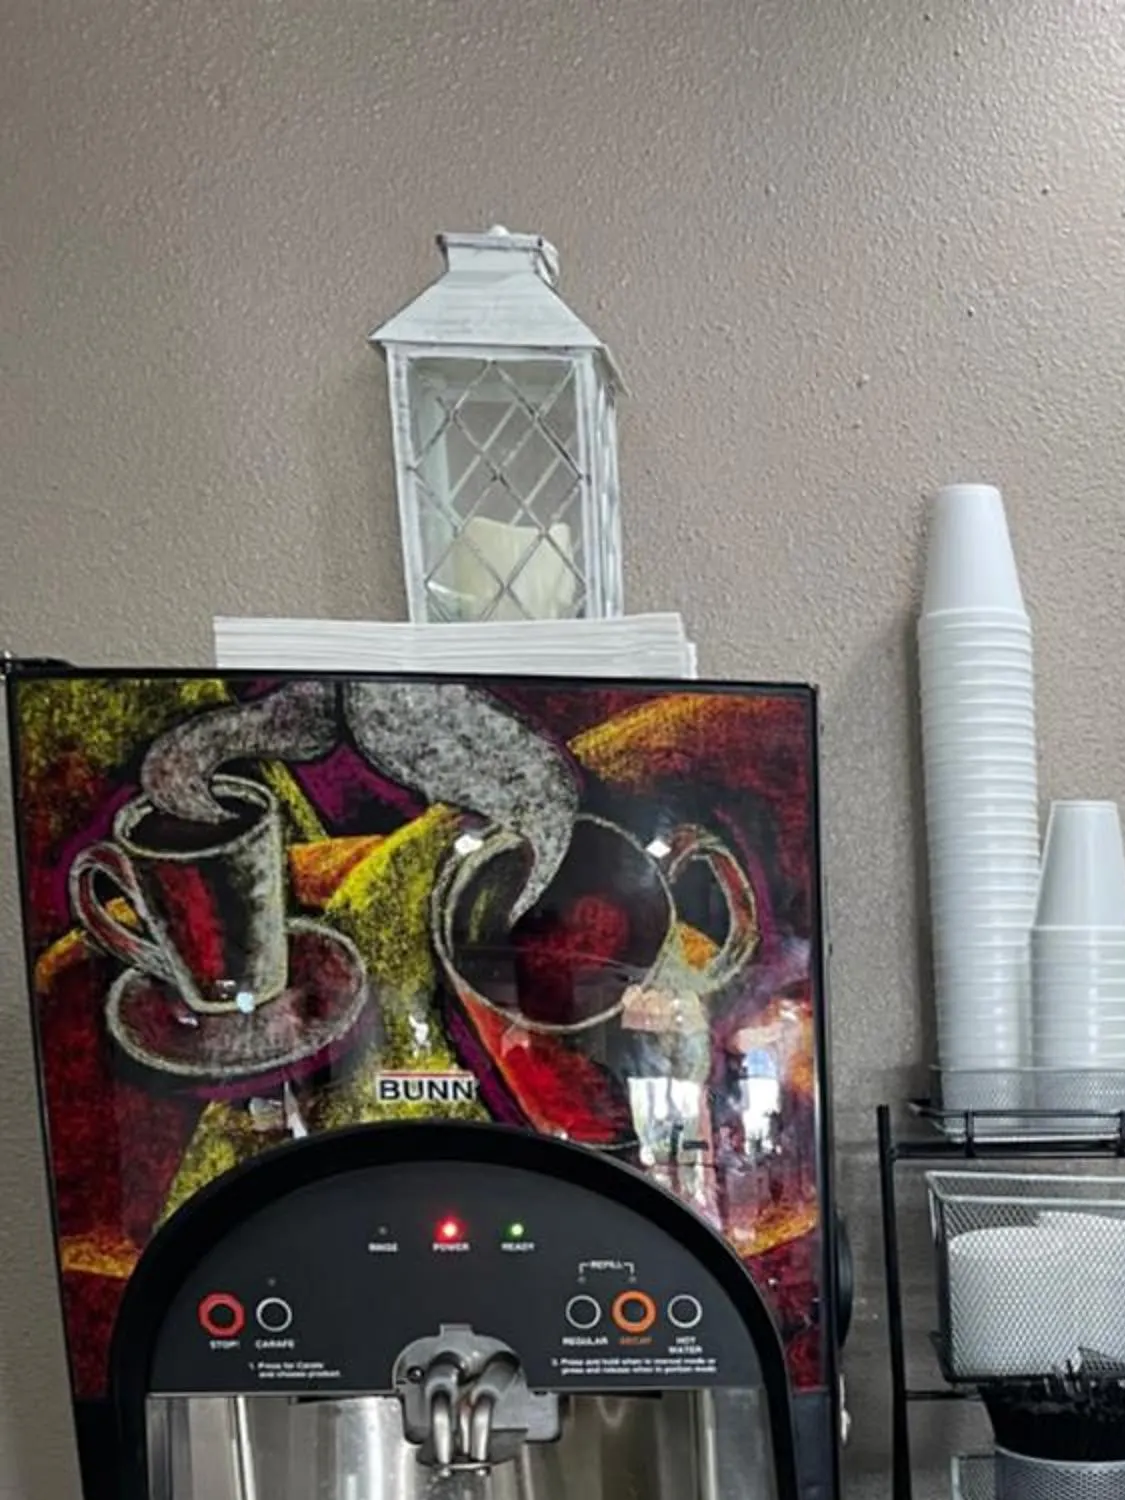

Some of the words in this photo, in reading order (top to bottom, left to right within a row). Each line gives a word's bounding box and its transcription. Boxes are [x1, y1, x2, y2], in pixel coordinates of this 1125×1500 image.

[380, 1079, 473, 1100] BUNN
[432, 1242, 470, 1252] POWER
[501, 1242, 535, 1251] READY
[590, 1260, 623, 1269] REFILL
[254, 1339, 296, 1350] CARAFE
[562, 1337, 609, 1345] REGULAR
[668, 1346, 703, 1354] WATER
